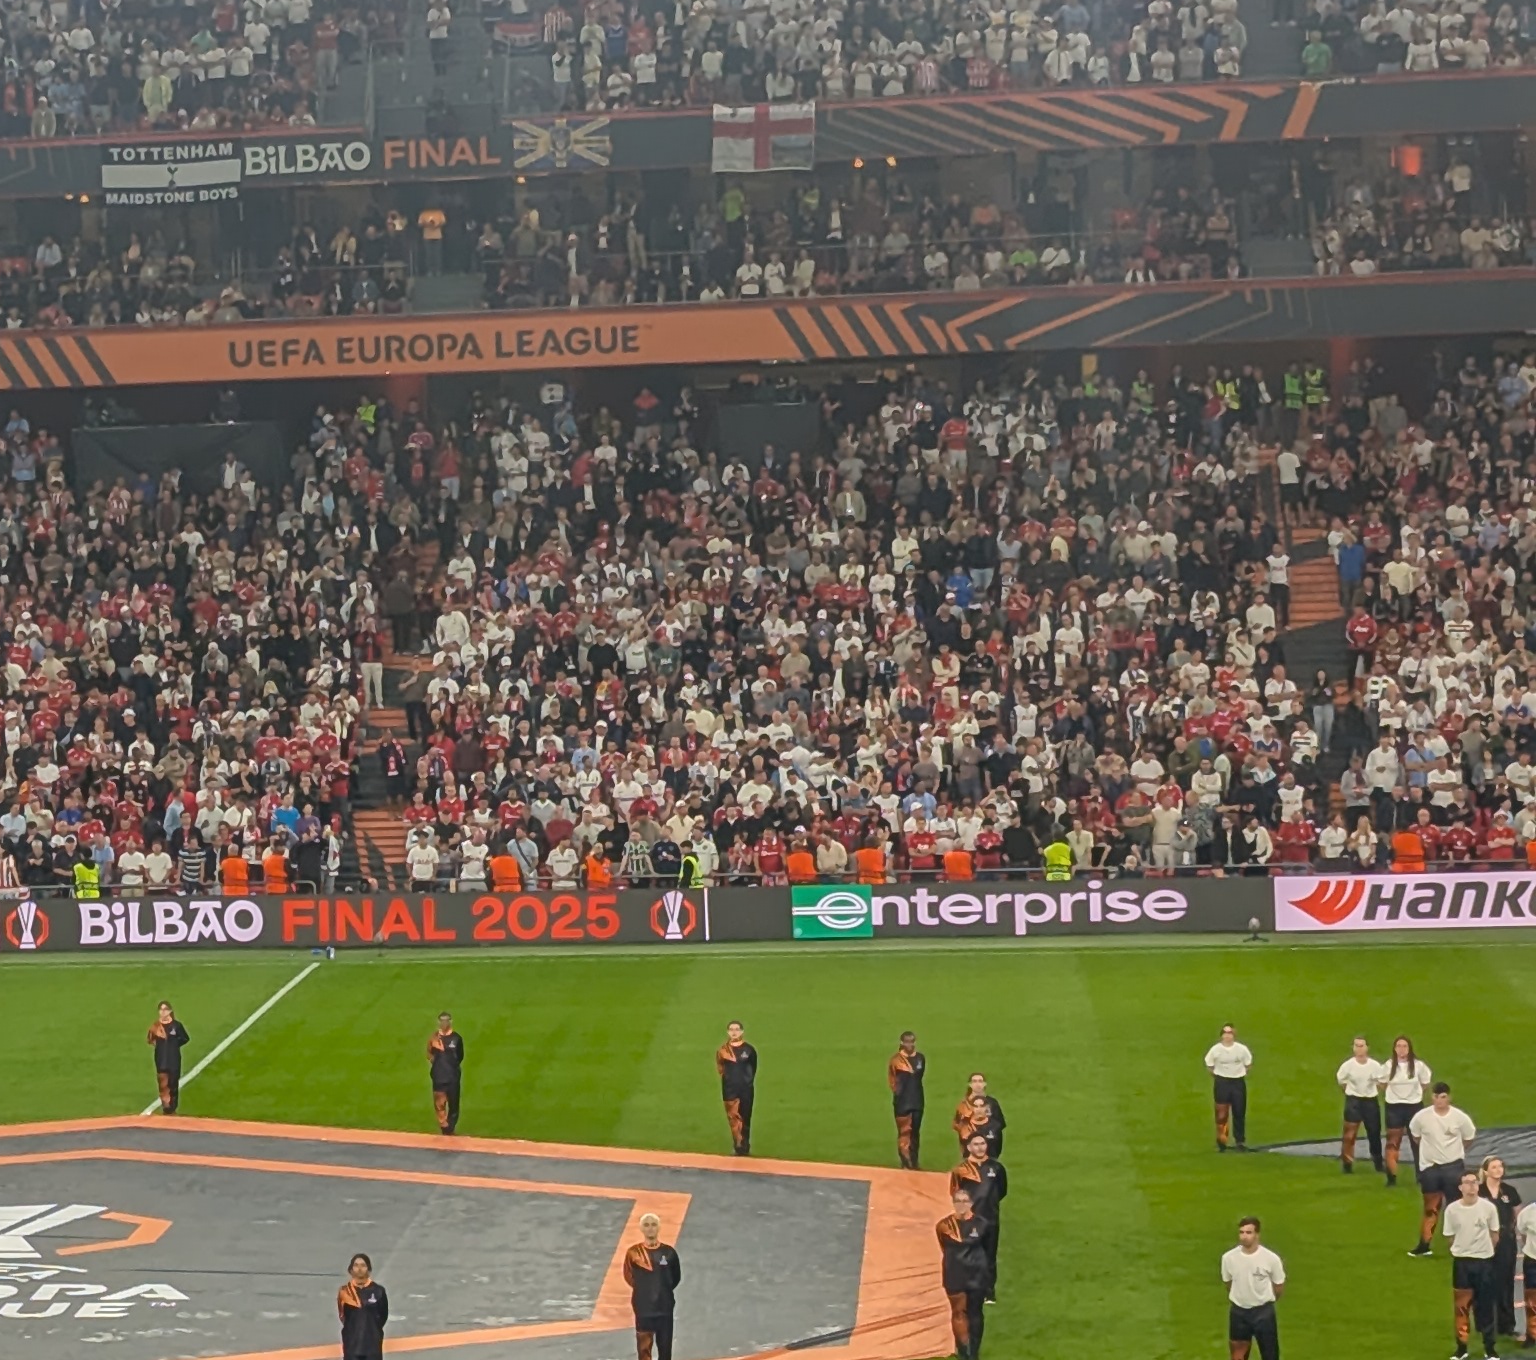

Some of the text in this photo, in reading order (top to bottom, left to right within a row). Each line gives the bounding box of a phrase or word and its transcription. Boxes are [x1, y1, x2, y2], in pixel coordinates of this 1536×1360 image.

[109, 142, 233, 161] TOTTENHAM
[384, 136, 502, 170] FINAL
[105, 187, 238, 205] MAIDSTONE BOYS
[228, 339, 326, 368] UEFA
[336, 330, 483, 364] EUROPA
[494, 324, 641, 359] LEAGUE
[281, 896, 456, 943] FINAL
[471, 894, 620, 940] 2025
[792, 880, 1187, 936] enterprise
